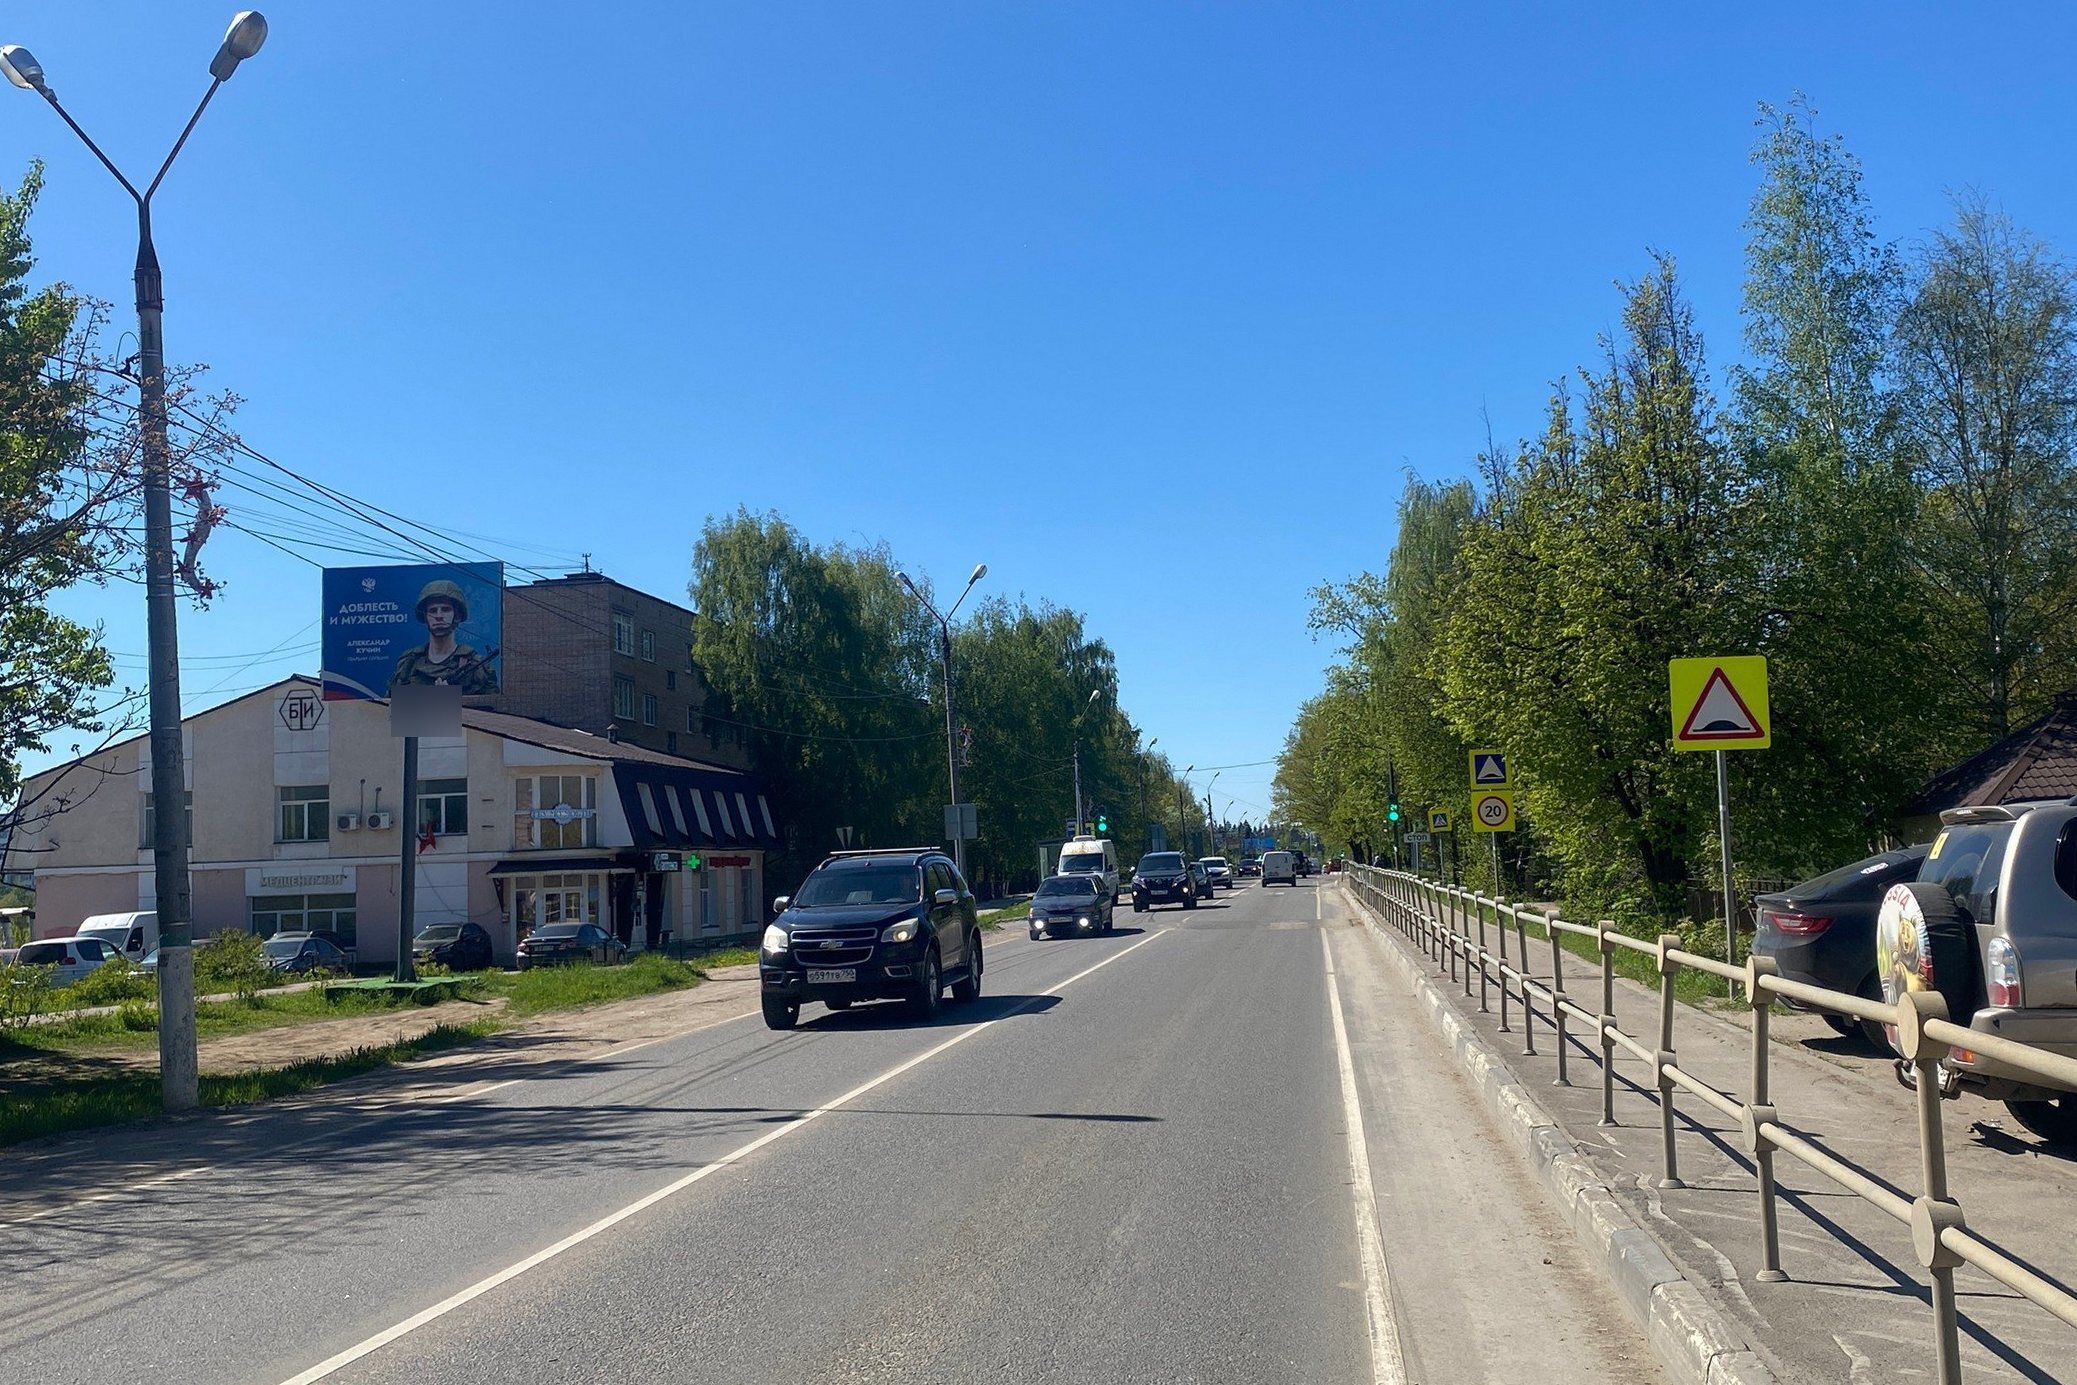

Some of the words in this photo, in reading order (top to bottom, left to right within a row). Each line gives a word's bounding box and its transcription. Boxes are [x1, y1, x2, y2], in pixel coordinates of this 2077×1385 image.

[339, 602, 399, 614] ДОБЛЕСТЬ
[329, 616, 338, 625] И
[341, 613, 408, 625] МУЖЕСТВО!
[288, 696, 314, 730] БТИ
[1485, 805, 1502, 818] 20
[1406, 834, 1428, 842] СТОП
